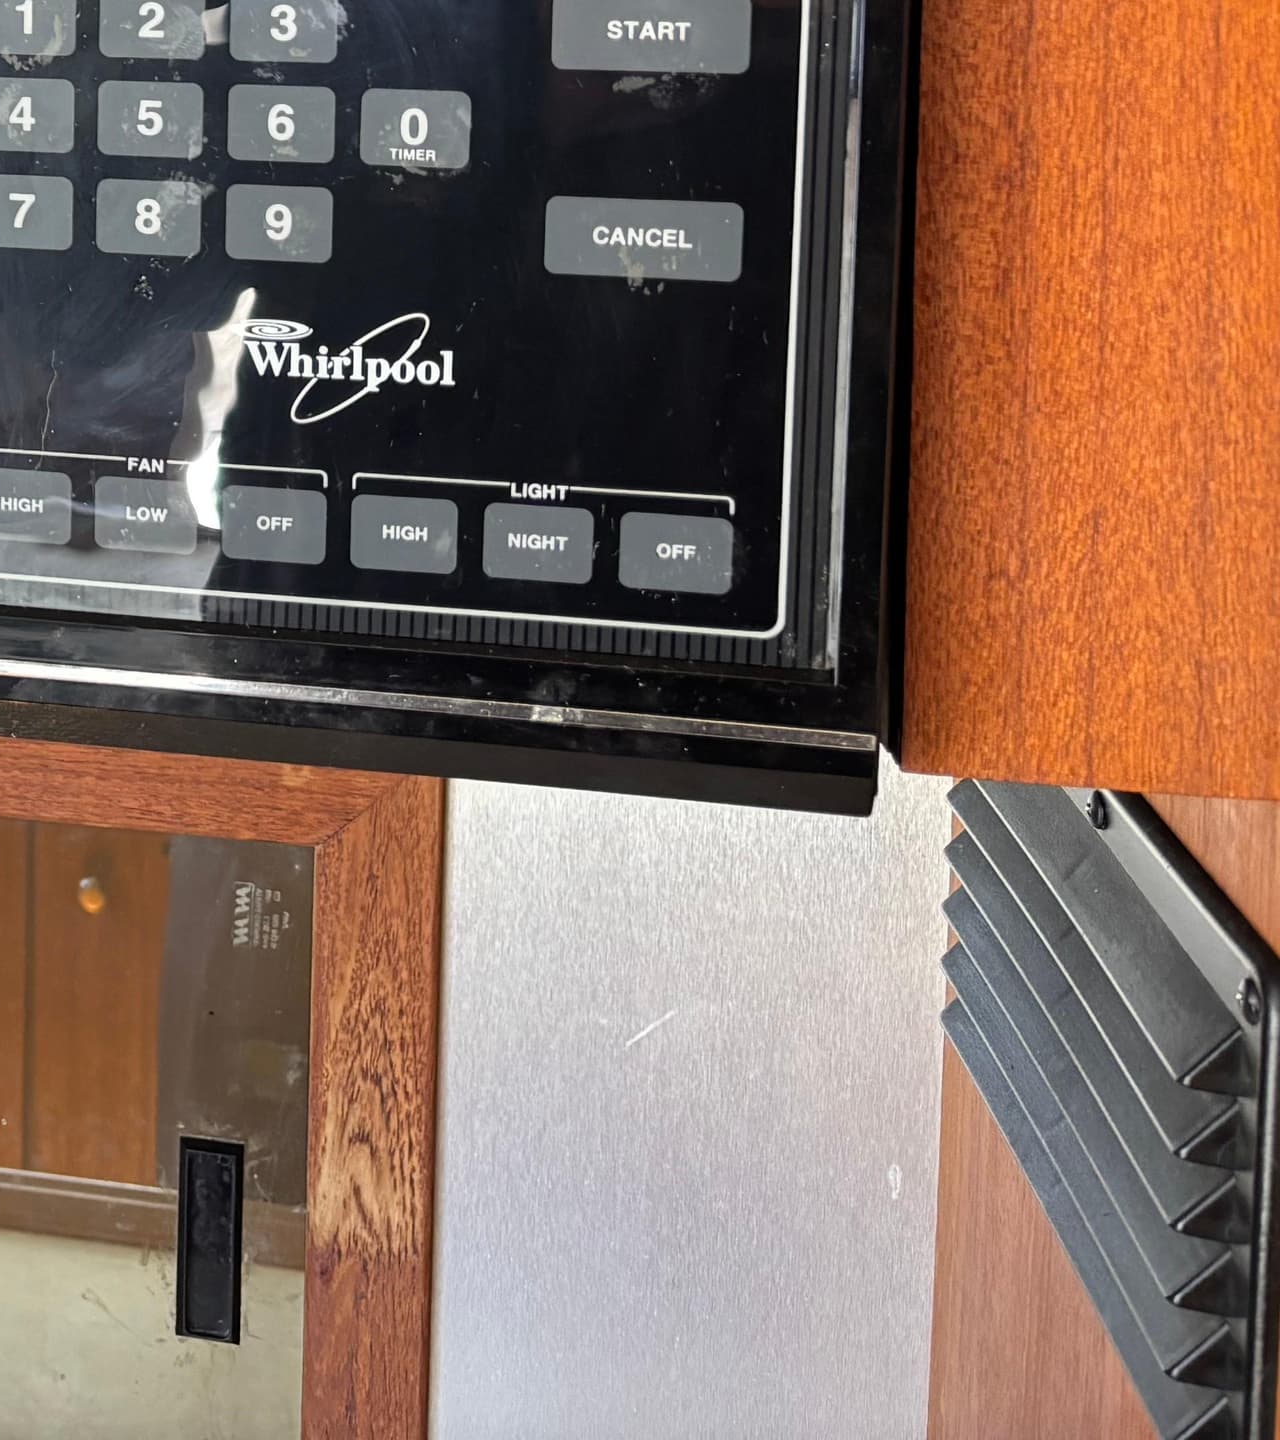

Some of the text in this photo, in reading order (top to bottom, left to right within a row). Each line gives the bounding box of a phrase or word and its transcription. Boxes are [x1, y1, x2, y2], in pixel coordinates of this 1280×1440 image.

[13, 0, 33, 34] 1
[137, 2, 166, 38] 2
[269, 4, 297, 41] 3
[606, 20, 692, 42] START
[7, 95, 37, 132] 4
[135, 100, 164, 136] 5
[266, 104, 295, 141] 6
[398, 108, 430, 146] 0
[388, 148, 437, 161] TIMER
[8, 193, 35, 229] 7
[134, 198, 162, 234] 8
[264, 204, 292, 240] 9
[591, 226, 693, 249] CANCEL
[245, 338, 456, 393] Whirlpool
[127, 457, 165, 474] FAN
[0, 496, 44, 513] HIGH
[510, 483, 568, 501] LIGHT
[125, 506, 168, 523] LOW
[255, 516, 294, 532] OFF
[381, 524, 429, 542] HIGH
[506, 532, 568, 552] NIGHT
[655, 542, 696, 560] OFF
